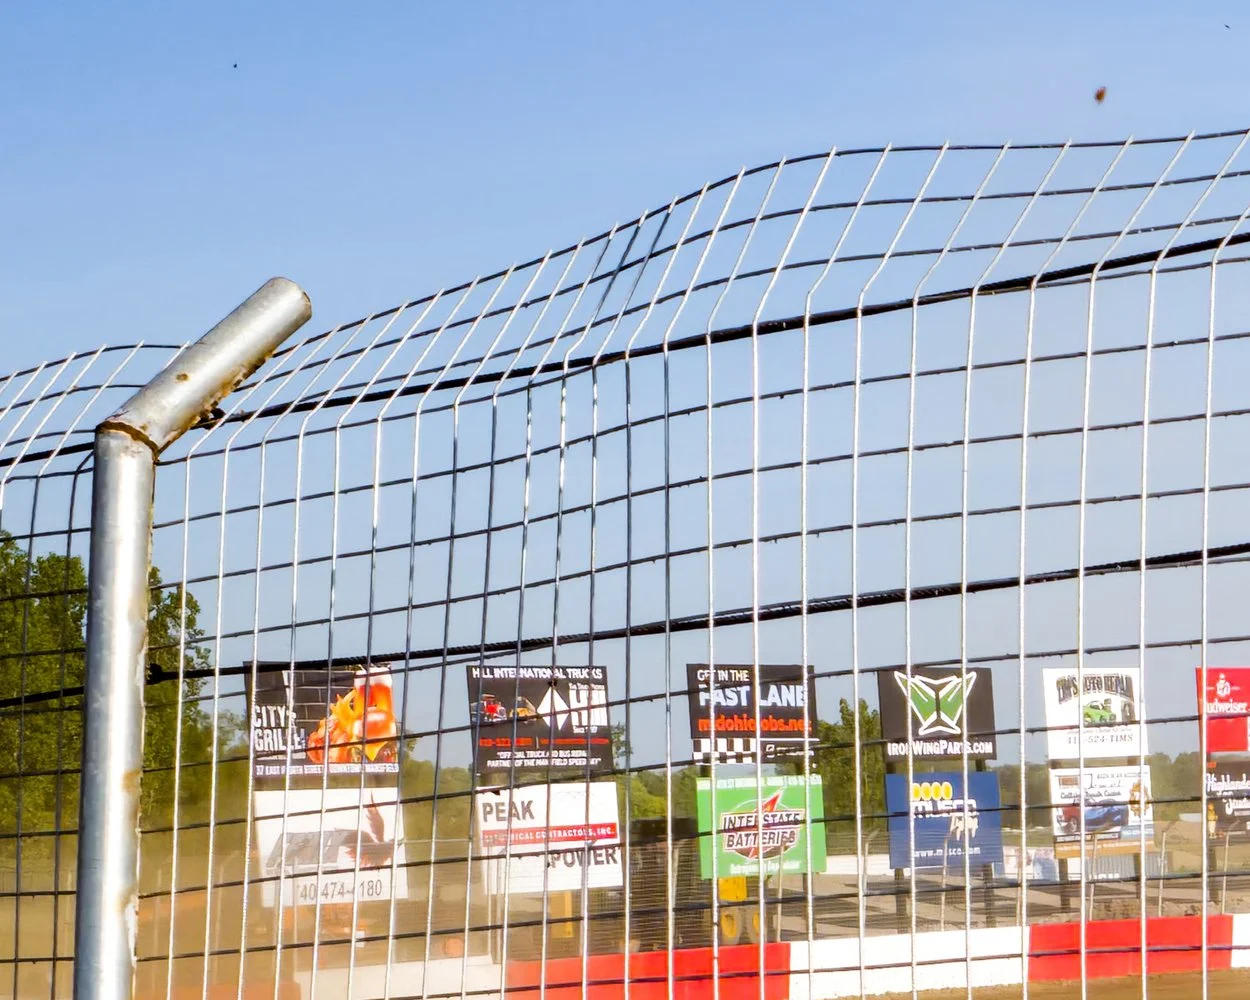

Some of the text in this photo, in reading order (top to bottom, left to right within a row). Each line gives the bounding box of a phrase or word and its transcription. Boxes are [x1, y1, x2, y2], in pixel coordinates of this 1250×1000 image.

[472, 668, 493, 679] HLL
[494, 668, 566, 679] INTENATIONAL
[717, 670, 729, 681] IN
[729, 670, 750, 681] THE
[698, 684, 807, 706] FAST LANE
[1206, 697, 1248, 714] udweiser
[253, 704, 287, 728] CITY
[1068, 734, 1133, 745] 41-524-TIMS
[487, 760, 512, 768] PARTNE
[536, 758, 567, 767] MANFIELD
[482, 800, 535, 822] PEAK
[726, 830, 797, 848] BATTERIES
[912, 846, 981, 857] www.msco.om
